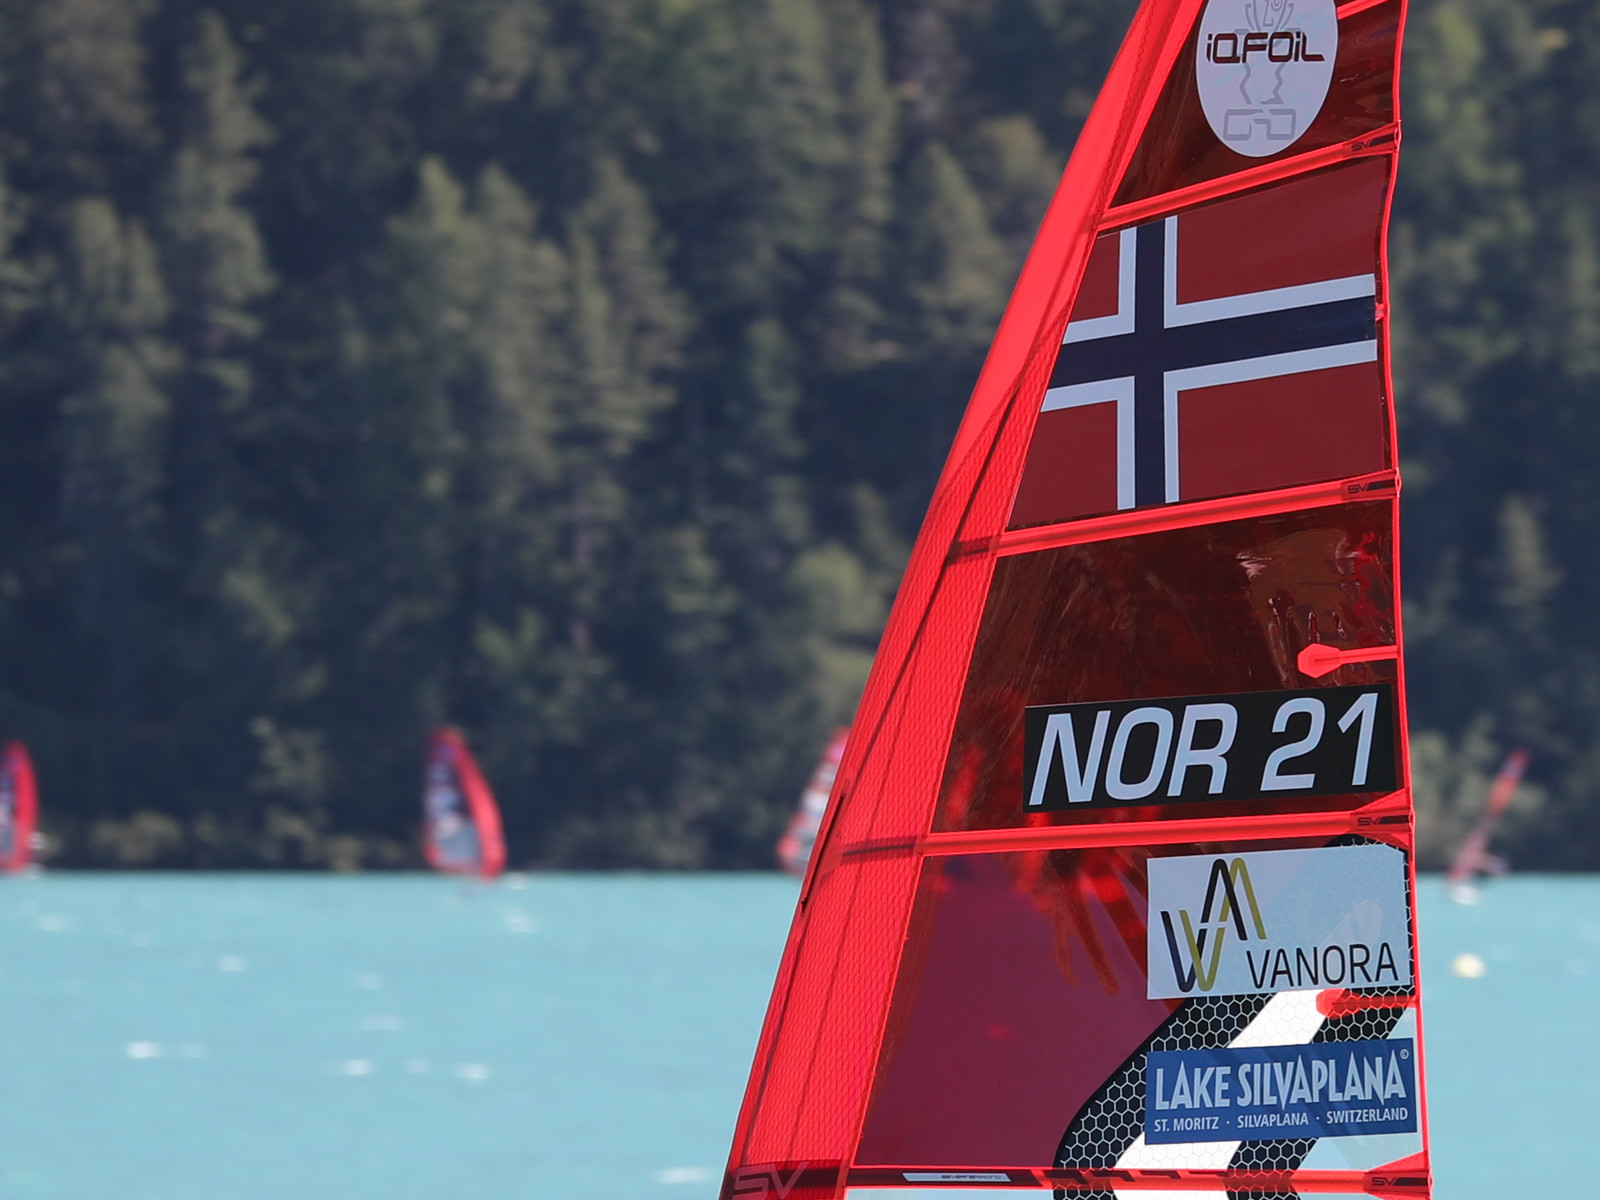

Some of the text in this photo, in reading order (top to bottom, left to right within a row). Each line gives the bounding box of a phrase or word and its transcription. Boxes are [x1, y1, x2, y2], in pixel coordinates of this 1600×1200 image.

[1029, 692, 1379, 806] NOR 21
[1246, 942, 1399, 989] VANORA
[1155, 1049, 1407, 1111] LAKE SILVAPLANA
[1154, 1106, 1408, 1132] ST. MORITZ SILVAPLANA SWITZERLAND
